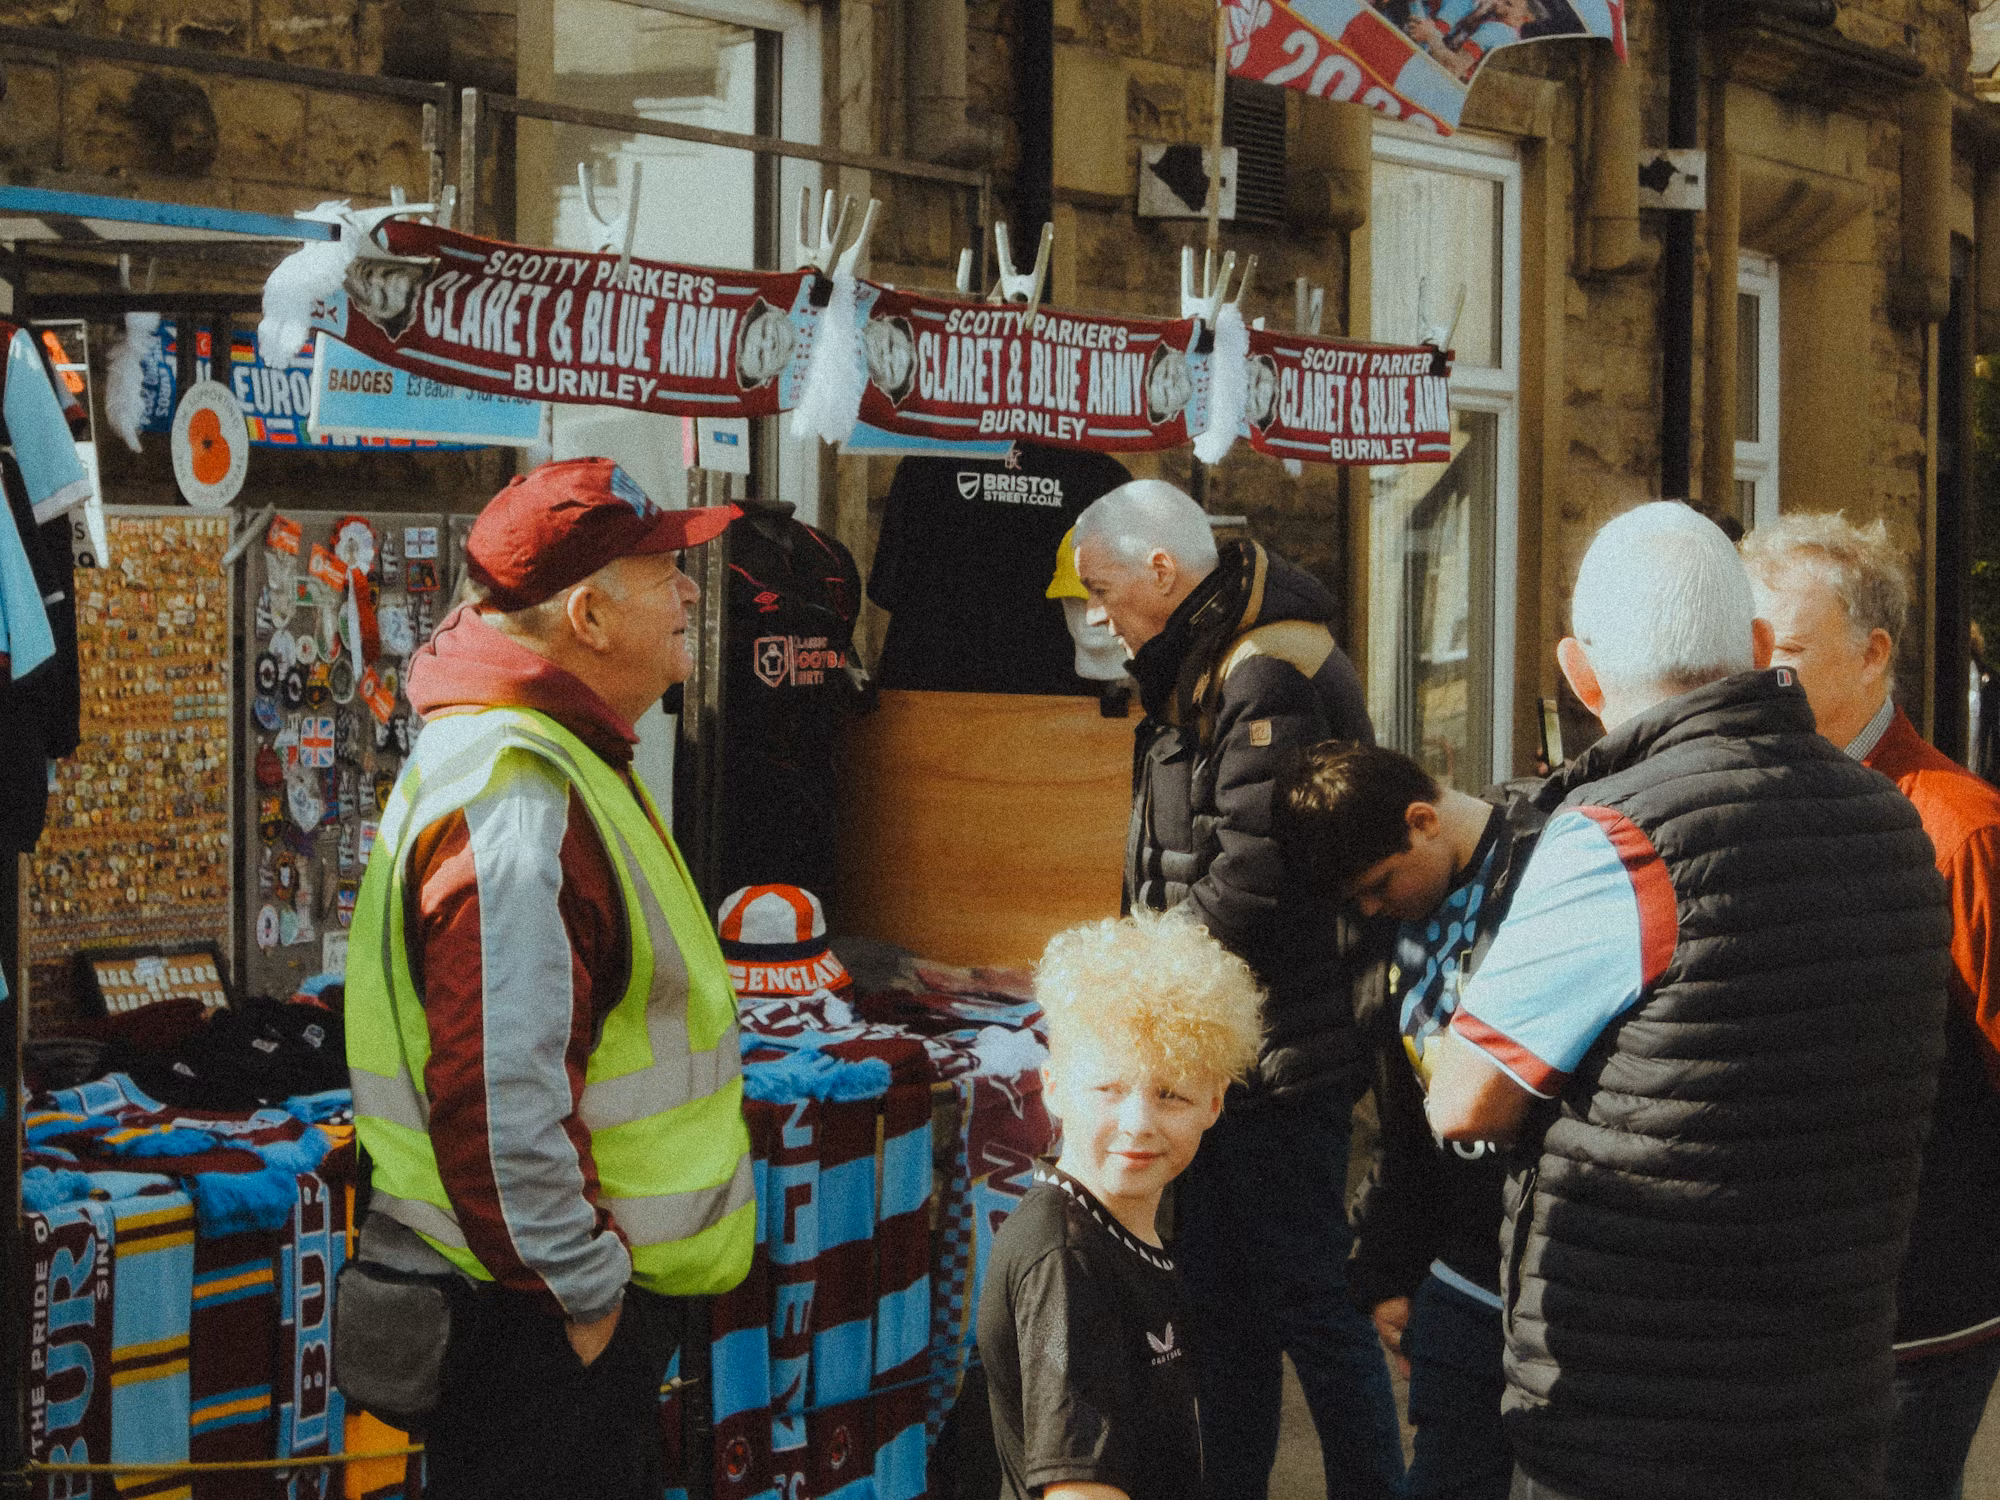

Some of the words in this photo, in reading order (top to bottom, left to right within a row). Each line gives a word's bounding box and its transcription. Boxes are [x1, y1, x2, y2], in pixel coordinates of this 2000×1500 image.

[483, 250, 590, 286] SCOTTY
[593, 261, 715, 304] PARKER'S
[423, 270, 551, 358] CLARET
[549, 289, 574, 365] &
[580, 290, 655, 371] BLUE
[659, 302, 738, 379] ARMY
[945, 309, 1026, 336] SCOTTY
[1032, 317, 1128, 350] PARKER'S
[918, 331, 1003, 404] CLARET
[1006, 339, 1024, 405] &
[1028, 340, 1081, 413] BLUE
[1087, 349, 1146, 416] ARMY
[1301, 347, 1367, 374] SCOTTY
[1370, 353, 1433, 376] PARKER
[233, 366, 312, 416] EURO
[327, 368, 393, 394] BADGES
[406, 374, 421, 397] £3
[514, 363, 657, 403] BURNLEY
[1279, 367, 1347, 433] CLARET
[1350, 377, 1365, 435] &
[1368, 376, 1411, 435] BLUE
[1414, 376, 1450, 433] ARM
[979, 409, 1087, 441] BURNLEY
[1330, 438, 1415, 460] BURNLEY
[983, 473, 1063, 496] BRISTOL
[983, 490, 1062, 507] STREET.CO.UK
[748, 951, 844, 991] ENGLAN
[31, 1260, 49, 1370] PRIDE
[31, 1385, 45, 1456] THE
